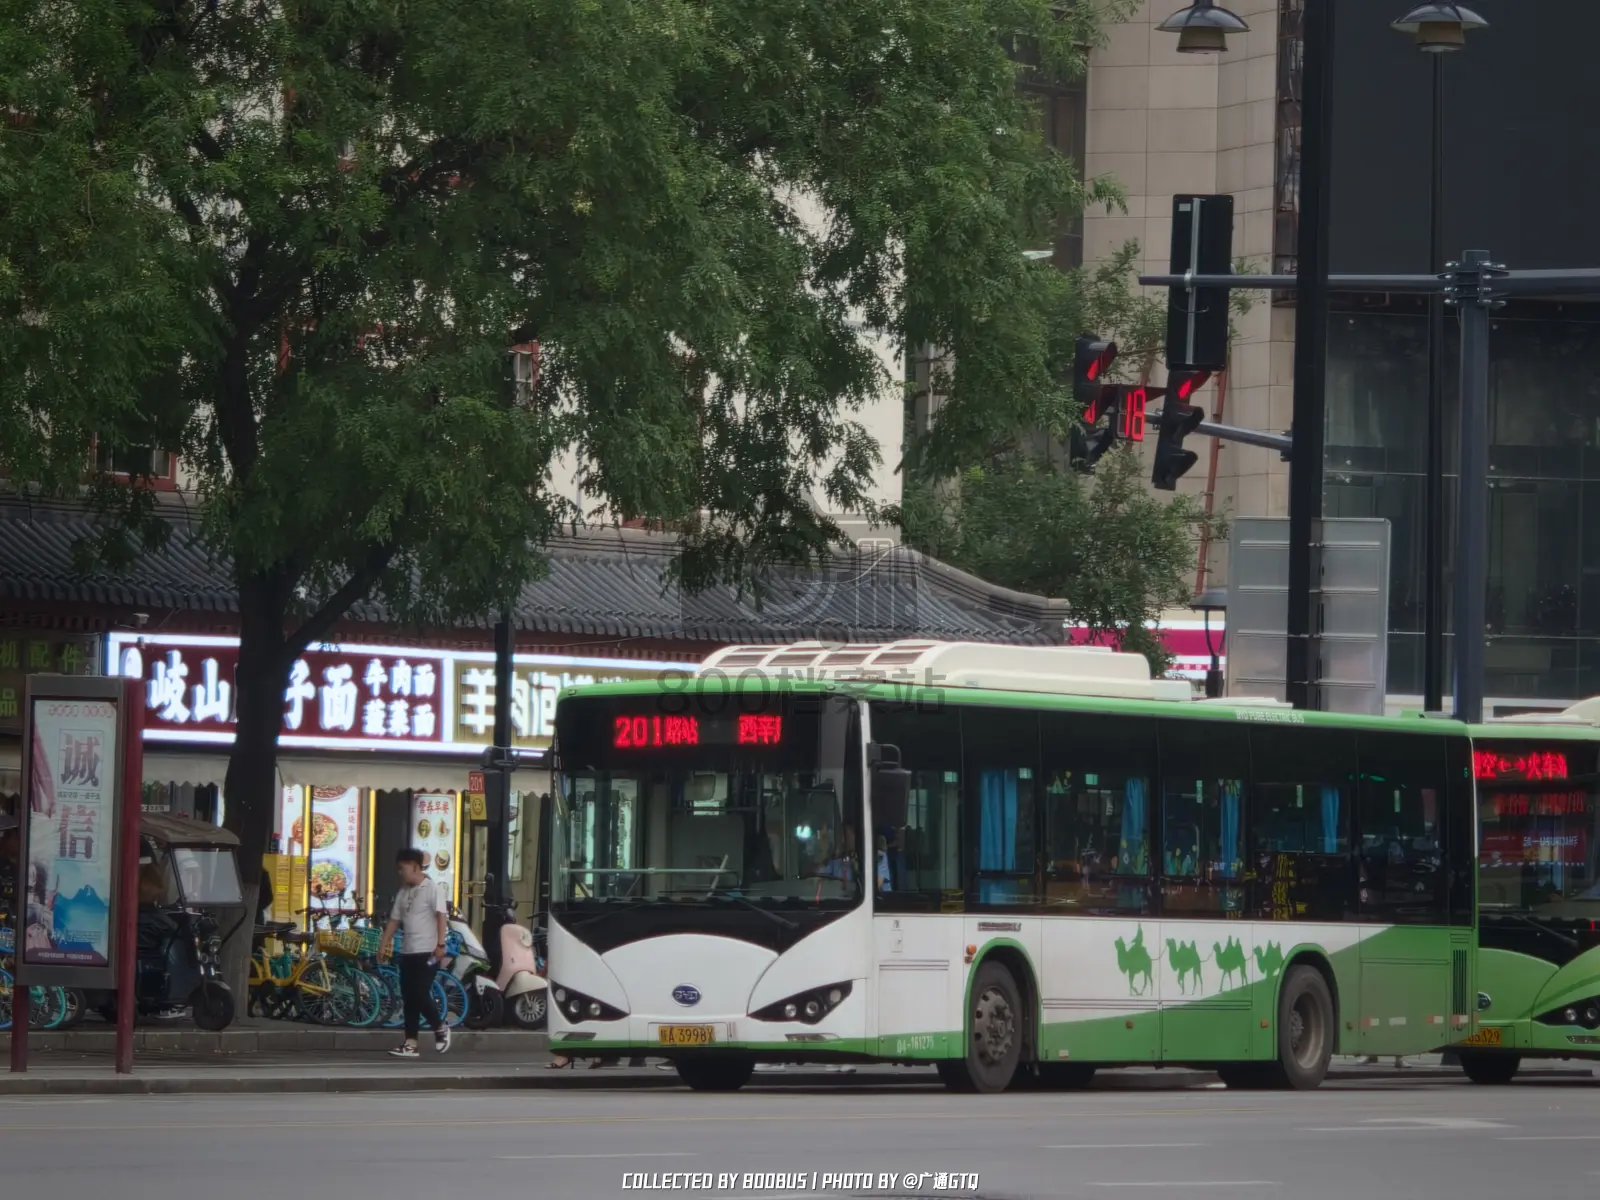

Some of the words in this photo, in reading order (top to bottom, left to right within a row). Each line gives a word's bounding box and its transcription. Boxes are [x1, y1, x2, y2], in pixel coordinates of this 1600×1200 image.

[1125, 387, 1146, 441] 18
[146, 650, 358, 731] 岐山子面
[363, 658, 436, 697] 牛肉面
[61, 731, 100, 787] 诚
[470, 776, 483, 791] 201
[57, 804, 97, 860] 信
